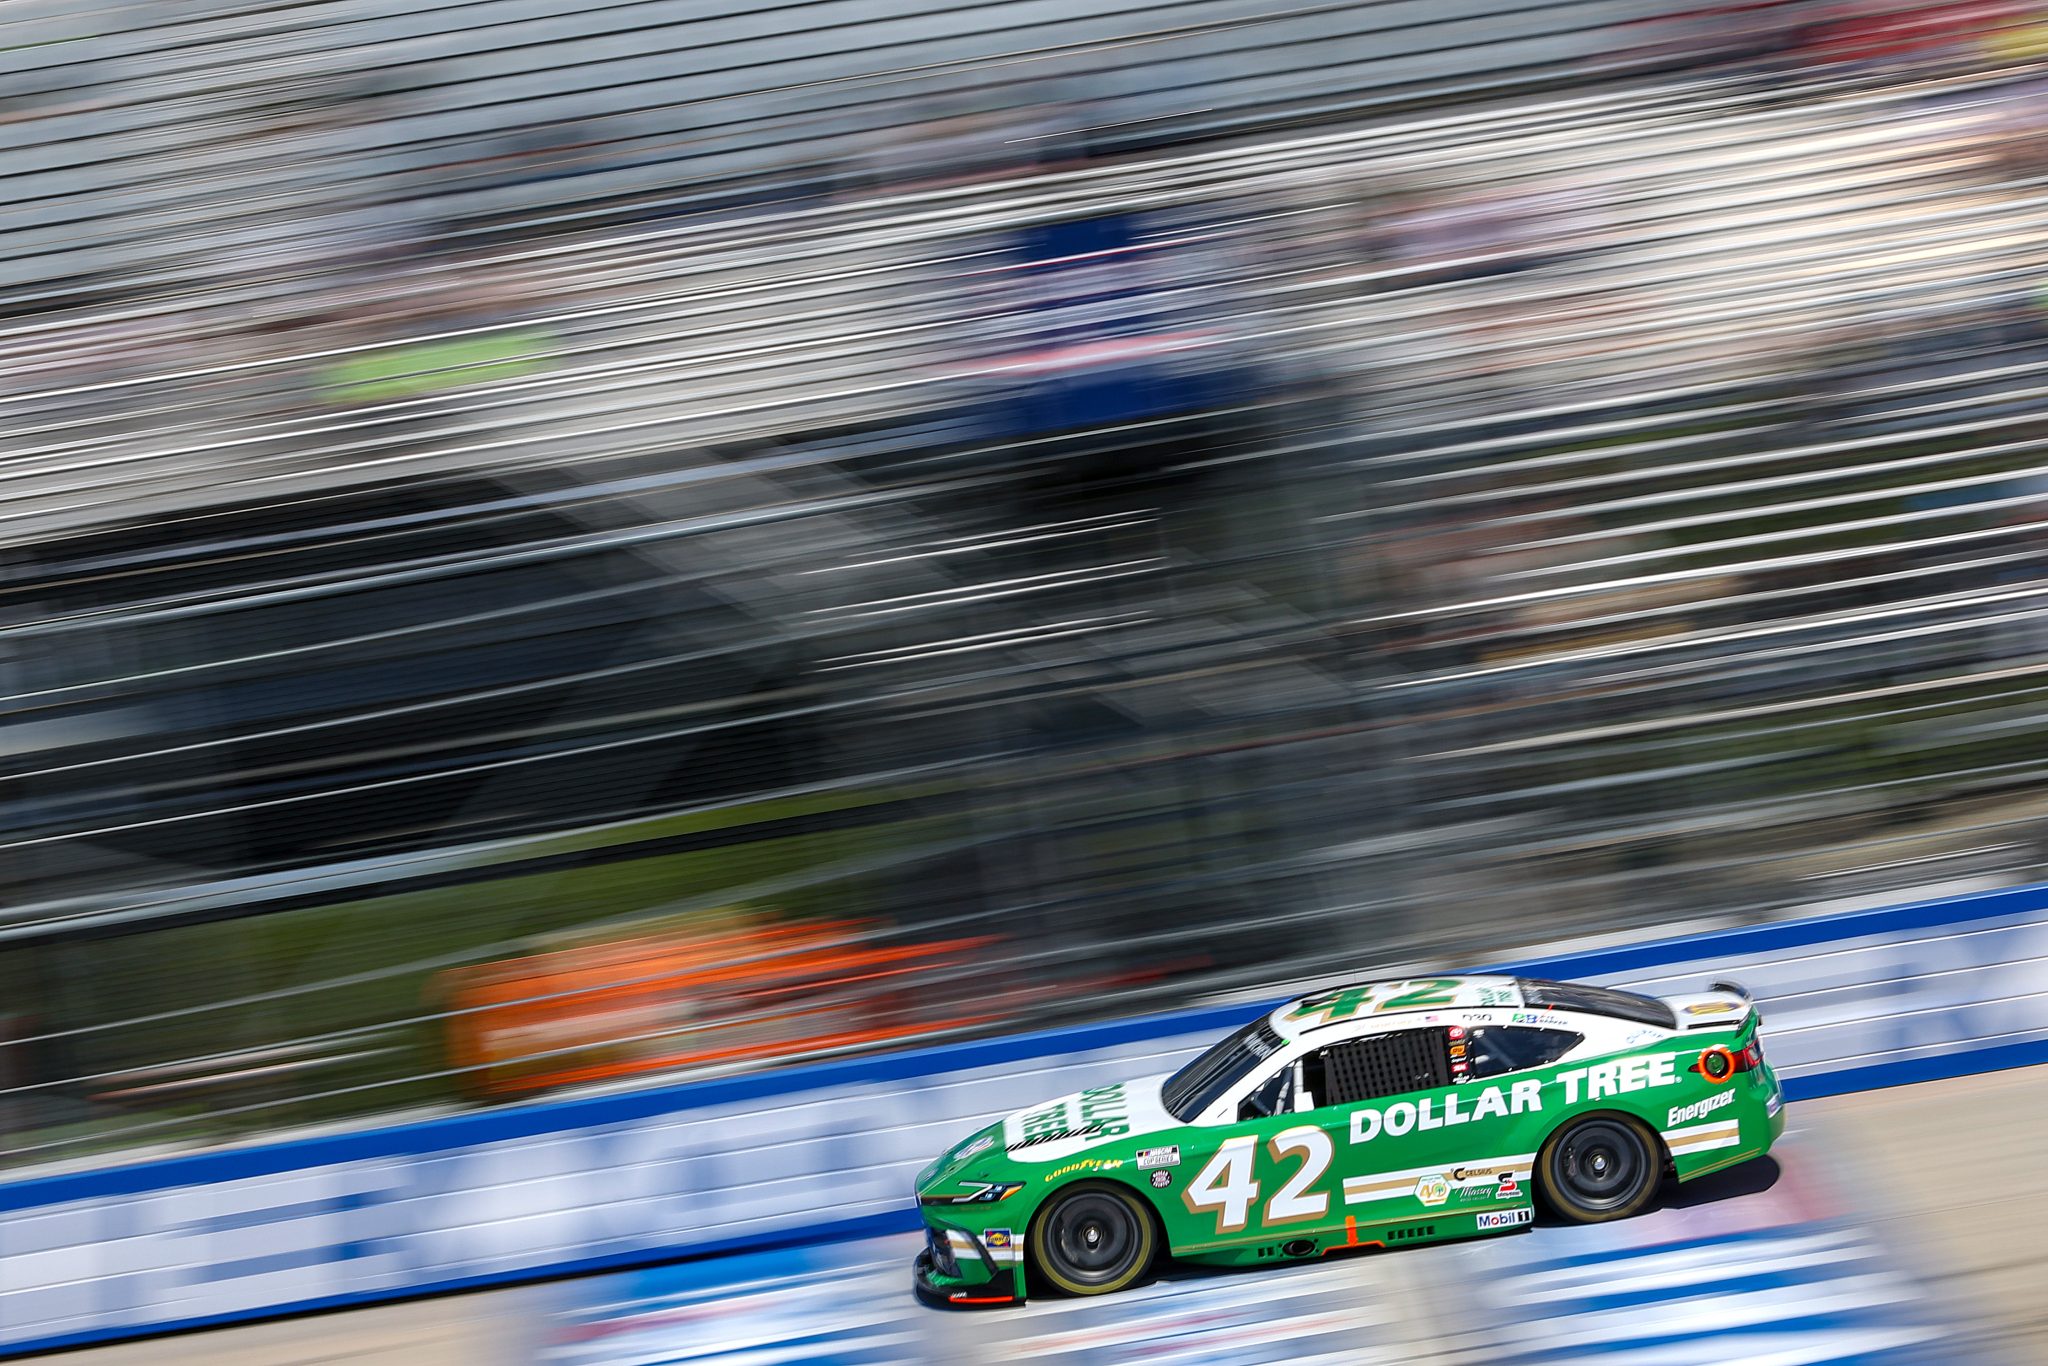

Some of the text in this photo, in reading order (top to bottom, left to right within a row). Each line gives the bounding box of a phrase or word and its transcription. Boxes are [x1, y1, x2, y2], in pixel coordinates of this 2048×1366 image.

[1350, 1052, 1676, 1144] DOLLAR TREE
[1667, 1088, 1736, 1128] Energizer
[1181, 1125, 1335, 1235] 42
[1466, 1168, 1493, 1177] CELSIUS
[1478, 1210, 1530, 1228] Mobil 1
